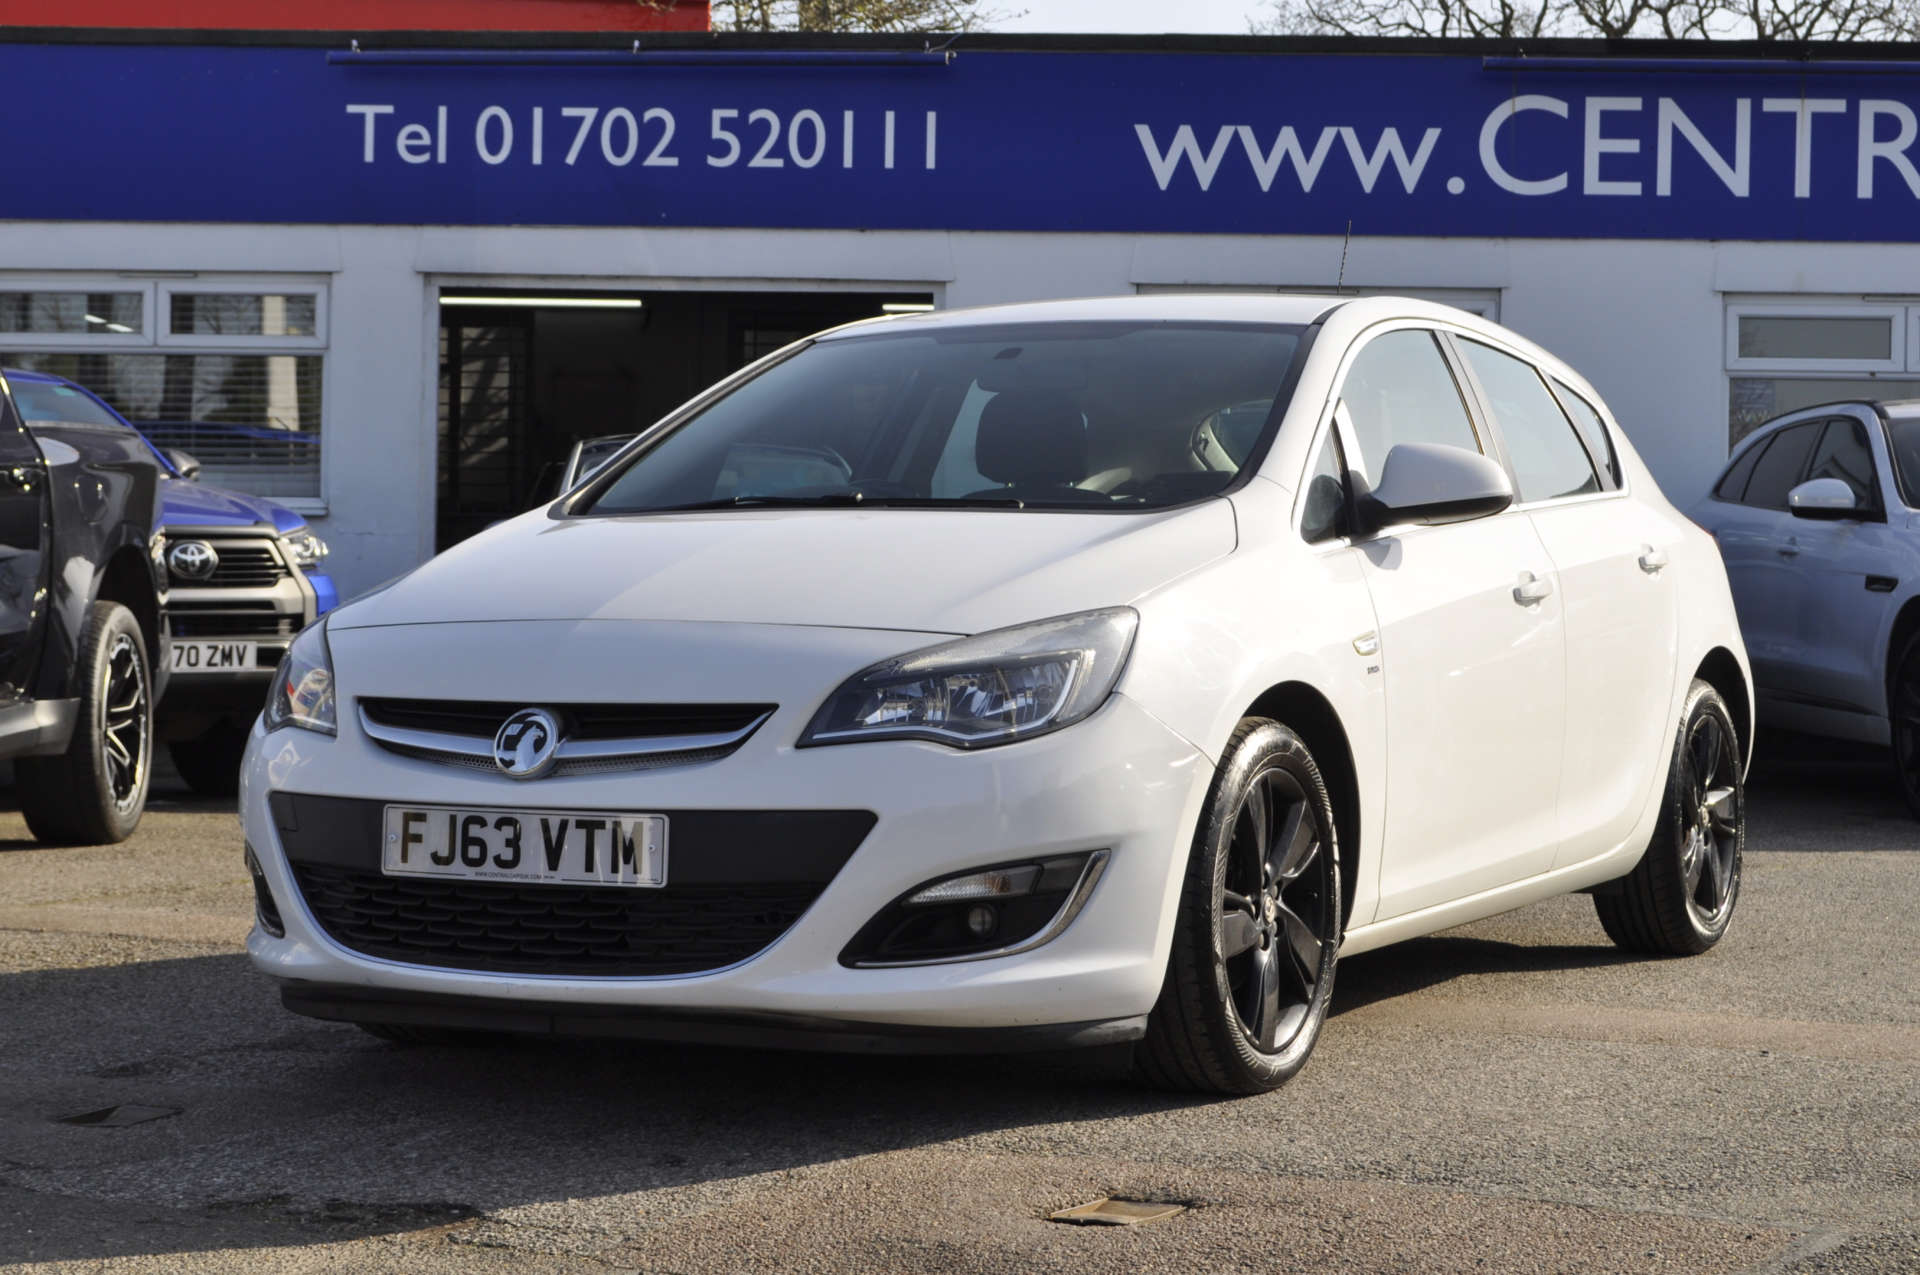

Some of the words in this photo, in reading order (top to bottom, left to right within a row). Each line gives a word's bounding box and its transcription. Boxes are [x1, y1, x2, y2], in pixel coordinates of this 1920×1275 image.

[346, 104, 447, 163] Tel
[475, 105, 679, 166] 01702
[706, 108, 937, 169] 520111
[1134, 94, 1920, 199] www.CENTR
[173, 644, 199, 667] 70
[206, 644, 247, 667] ZMV
[401, 811, 522, 870] FJ63
[540, 817, 644, 875] VTM
